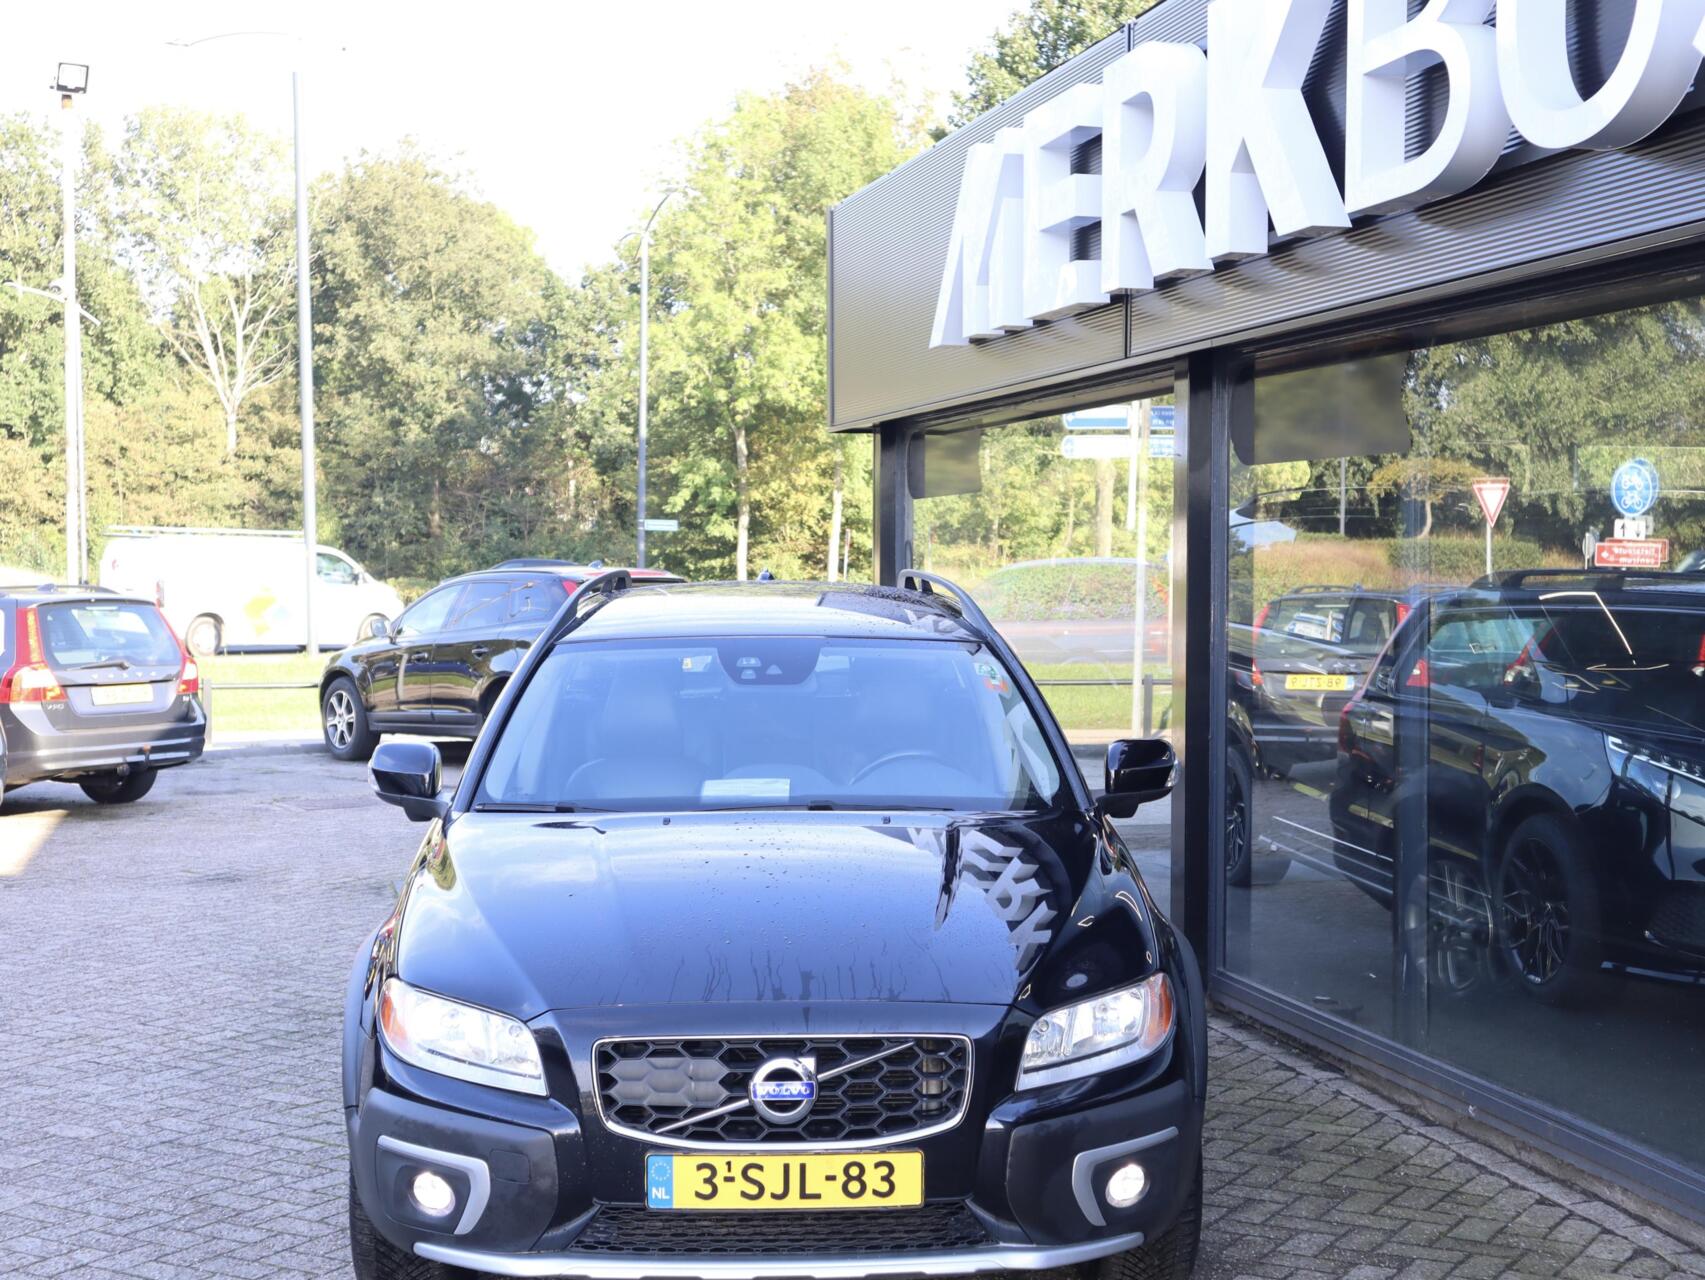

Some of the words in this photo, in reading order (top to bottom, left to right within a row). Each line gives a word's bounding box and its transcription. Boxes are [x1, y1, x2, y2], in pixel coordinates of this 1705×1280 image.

[929, 0, 1705, 349] MERKB
[757, 1085, 811, 1097] VOLVO
[651, 1186, 670, 1200] NL
